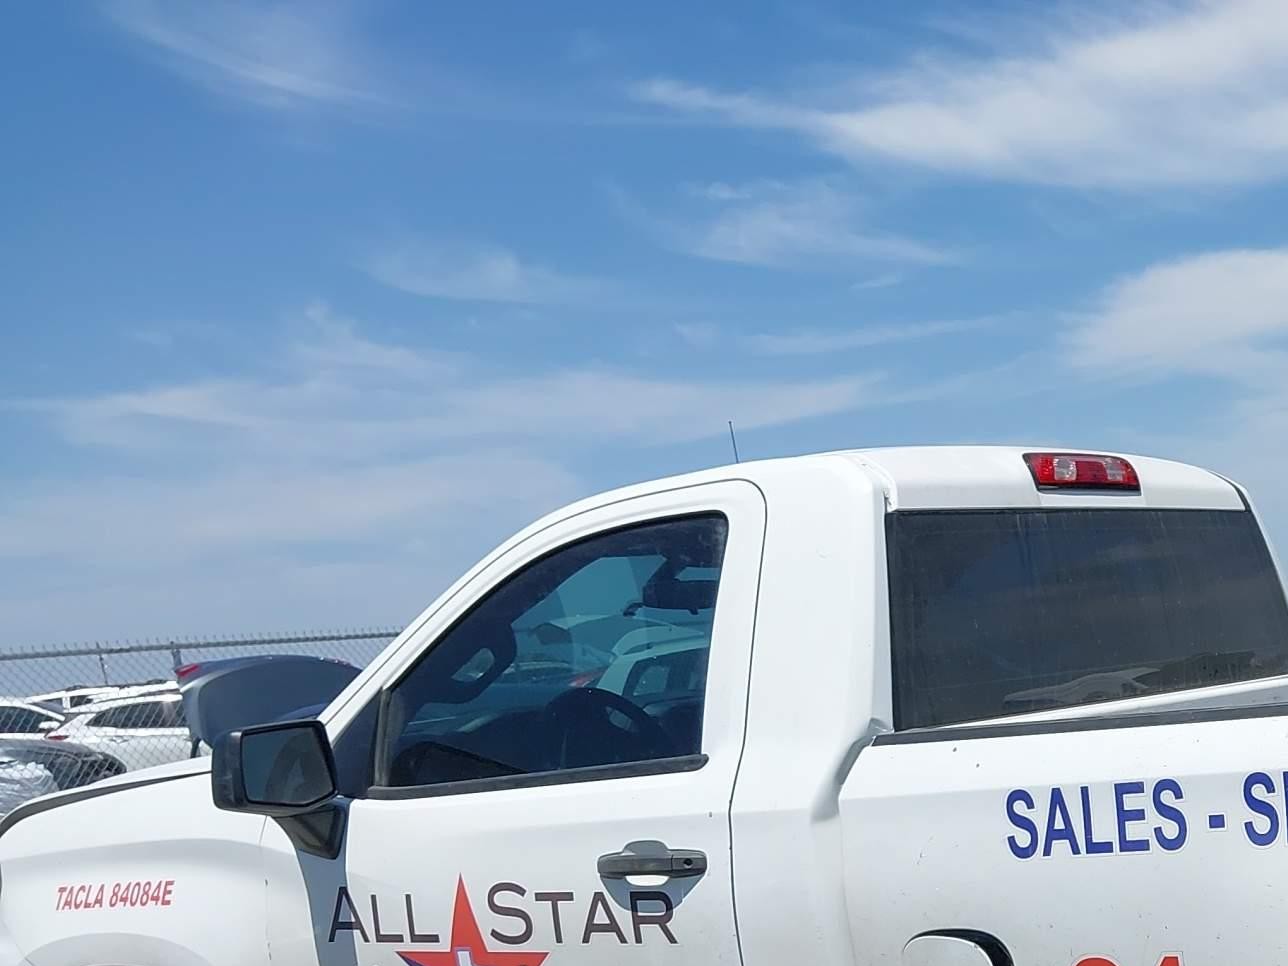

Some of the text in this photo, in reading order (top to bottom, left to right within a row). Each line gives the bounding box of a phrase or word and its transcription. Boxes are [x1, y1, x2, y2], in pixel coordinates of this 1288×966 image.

[1006, 777, 1187, 859] SALES
[56, 879, 174, 912] TACLA 84084E
[328, 882, 679, 945] ALL STAR
